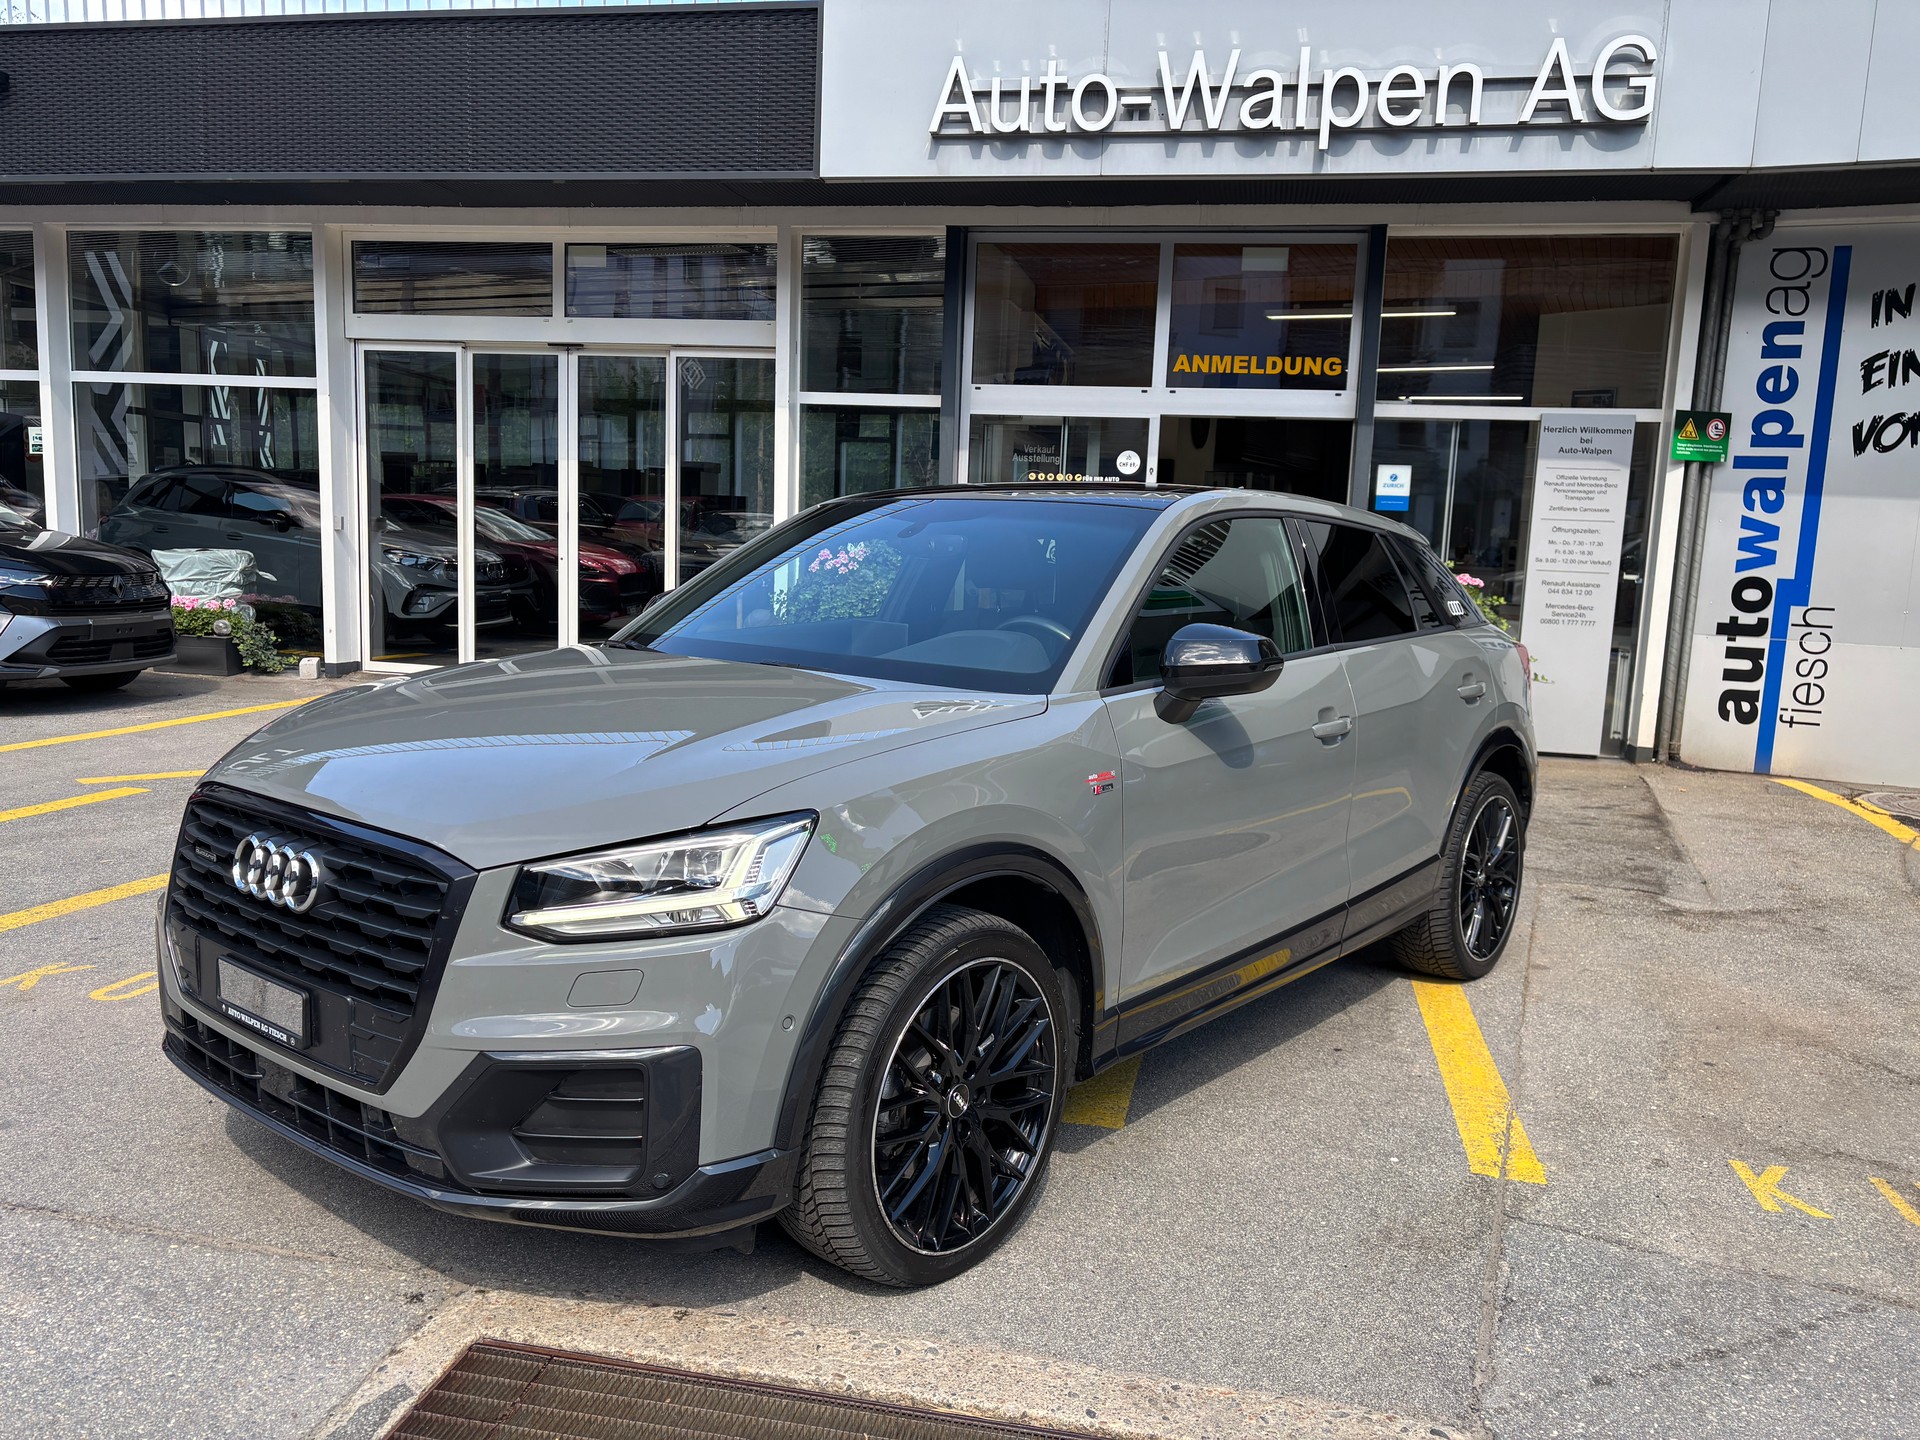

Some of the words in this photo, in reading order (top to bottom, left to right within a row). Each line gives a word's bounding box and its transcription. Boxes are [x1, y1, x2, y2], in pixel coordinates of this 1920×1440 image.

[929, 46, 1484, 150] Auto-Walpen
[1519, 34, 1657, 123] AG
[1871, 283, 1916, 328] IN
[1173, 354, 1342, 376] ANMELDUNG
[1543, 425, 1577, 433] Herzlich
[1580, 426, 1632, 435] Willkommen
[1024, 444, 1055, 454] Verkauf
[1558, 446, 1612, 456] Auto-Walpen
[1012, 453, 1060, 465] Ausstellung
[1552, 526, 1600, 535] Öffnungszeiten:
[1567, 581, 1600, 589] Assistance
[1545, 603, 1594, 611] Mercedes-Benz
[1779, 606, 1836, 729] fiesch
[227, 1007, 241, 1019] AUTO
[240, 1012, 261, 1030] WALPEN
[260, 1023, 269, 1033] AG
[268, 1026, 288, 1042] FIESCH
